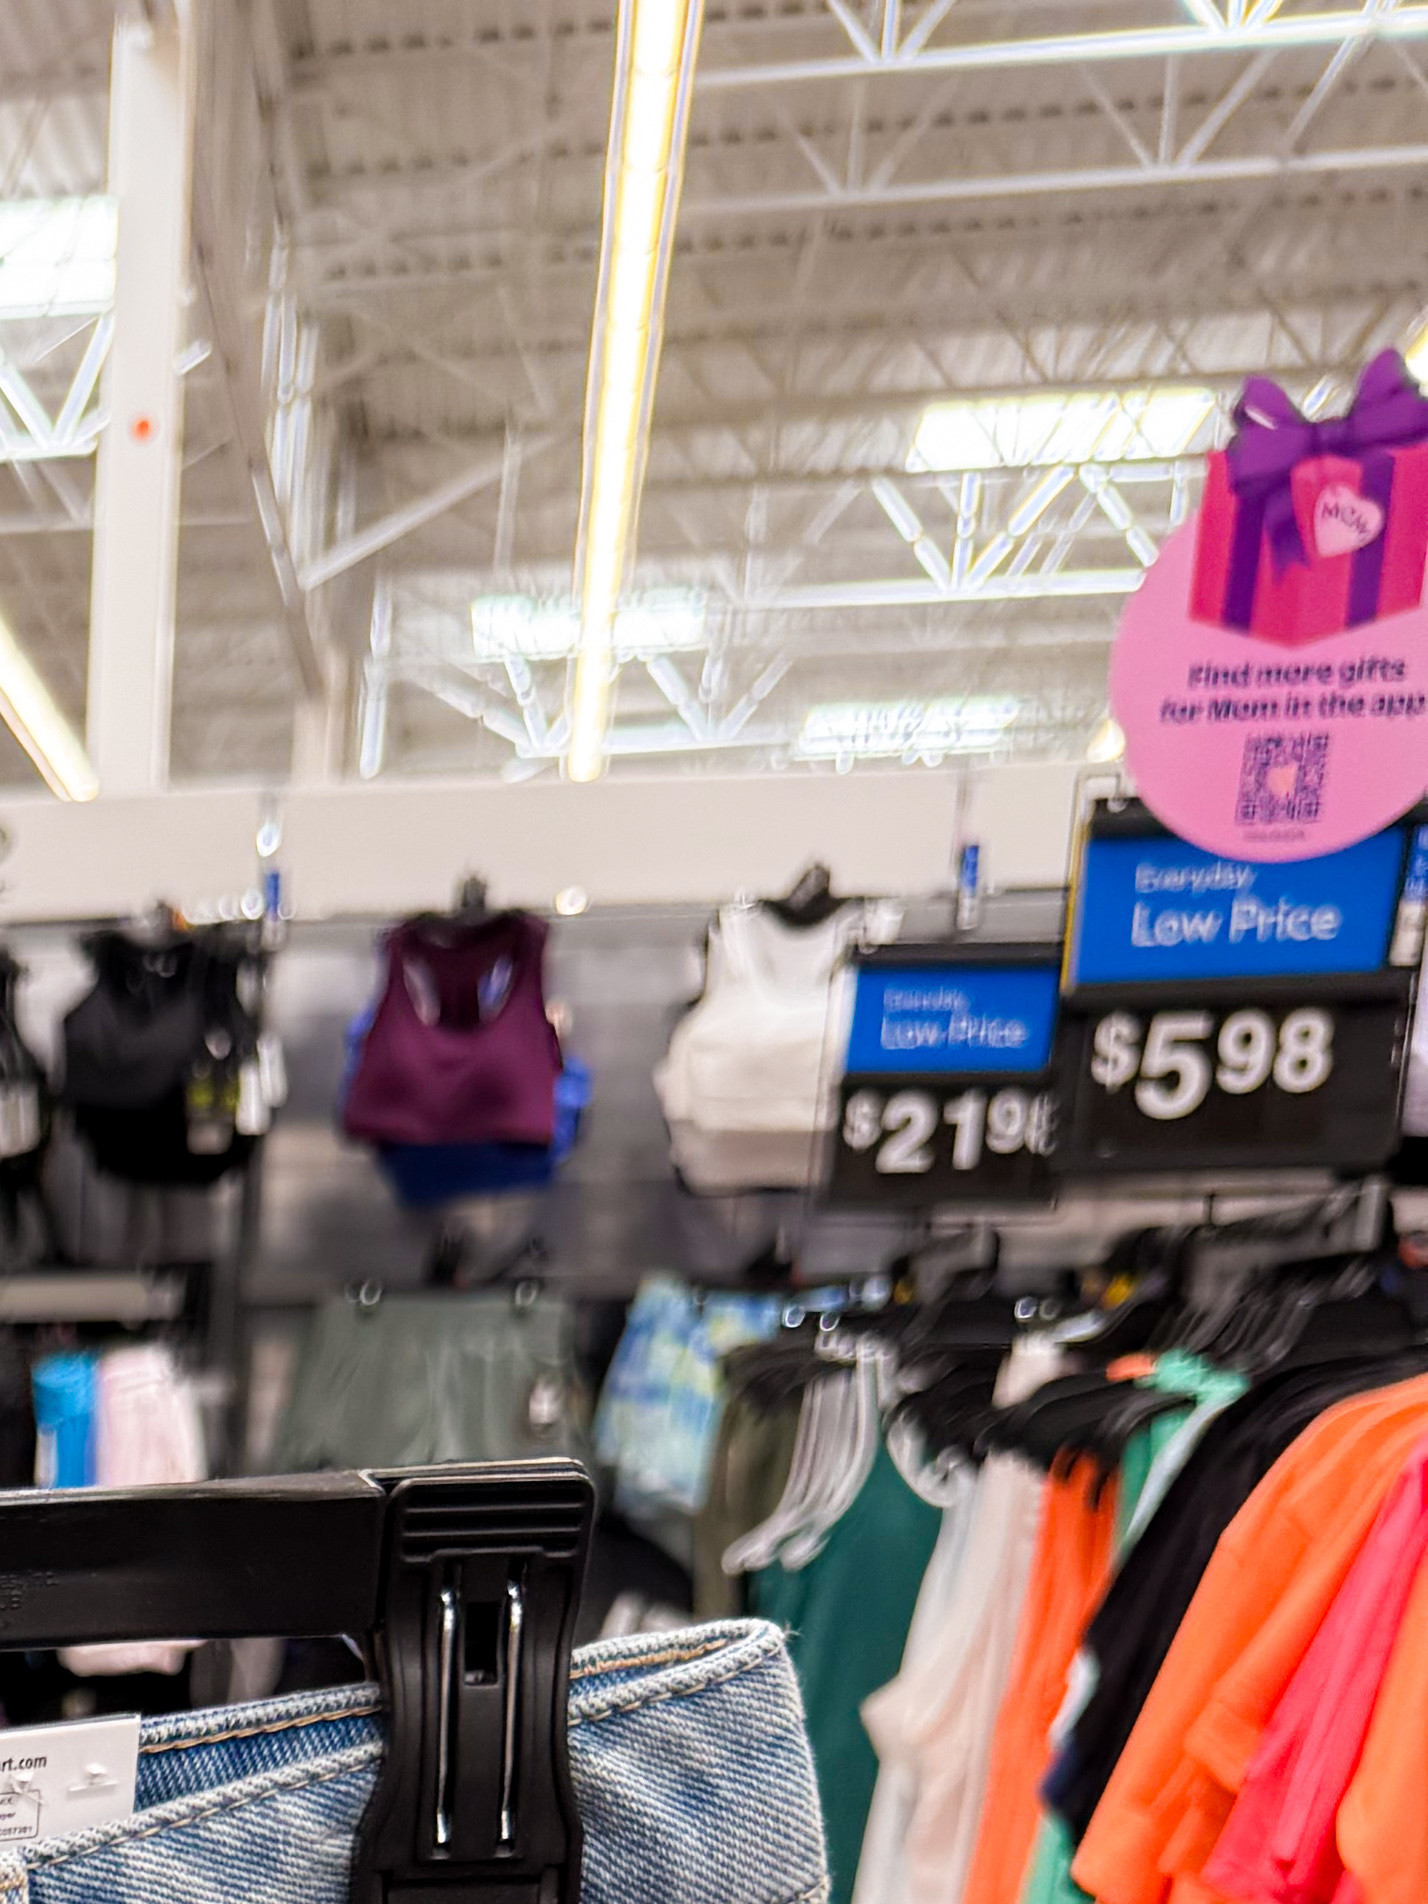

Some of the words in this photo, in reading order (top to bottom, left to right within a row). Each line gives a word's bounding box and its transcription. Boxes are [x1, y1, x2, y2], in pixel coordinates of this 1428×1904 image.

[1188, 662, 1251, 688] Find
[1257, 660, 1333, 687] more
[1339, 655, 1406, 689] gifts
[1159, 698, 1202, 724] for
[1207, 697, 1278, 723] Mom
[1283, 692, 1311, 718] in
[1319, 691, 1365, 718] the
[1135, 861, 1258, 895] Everyday
[1131, 899, 1223, 948] Low
[1229, 894, 1344, 945] Price
